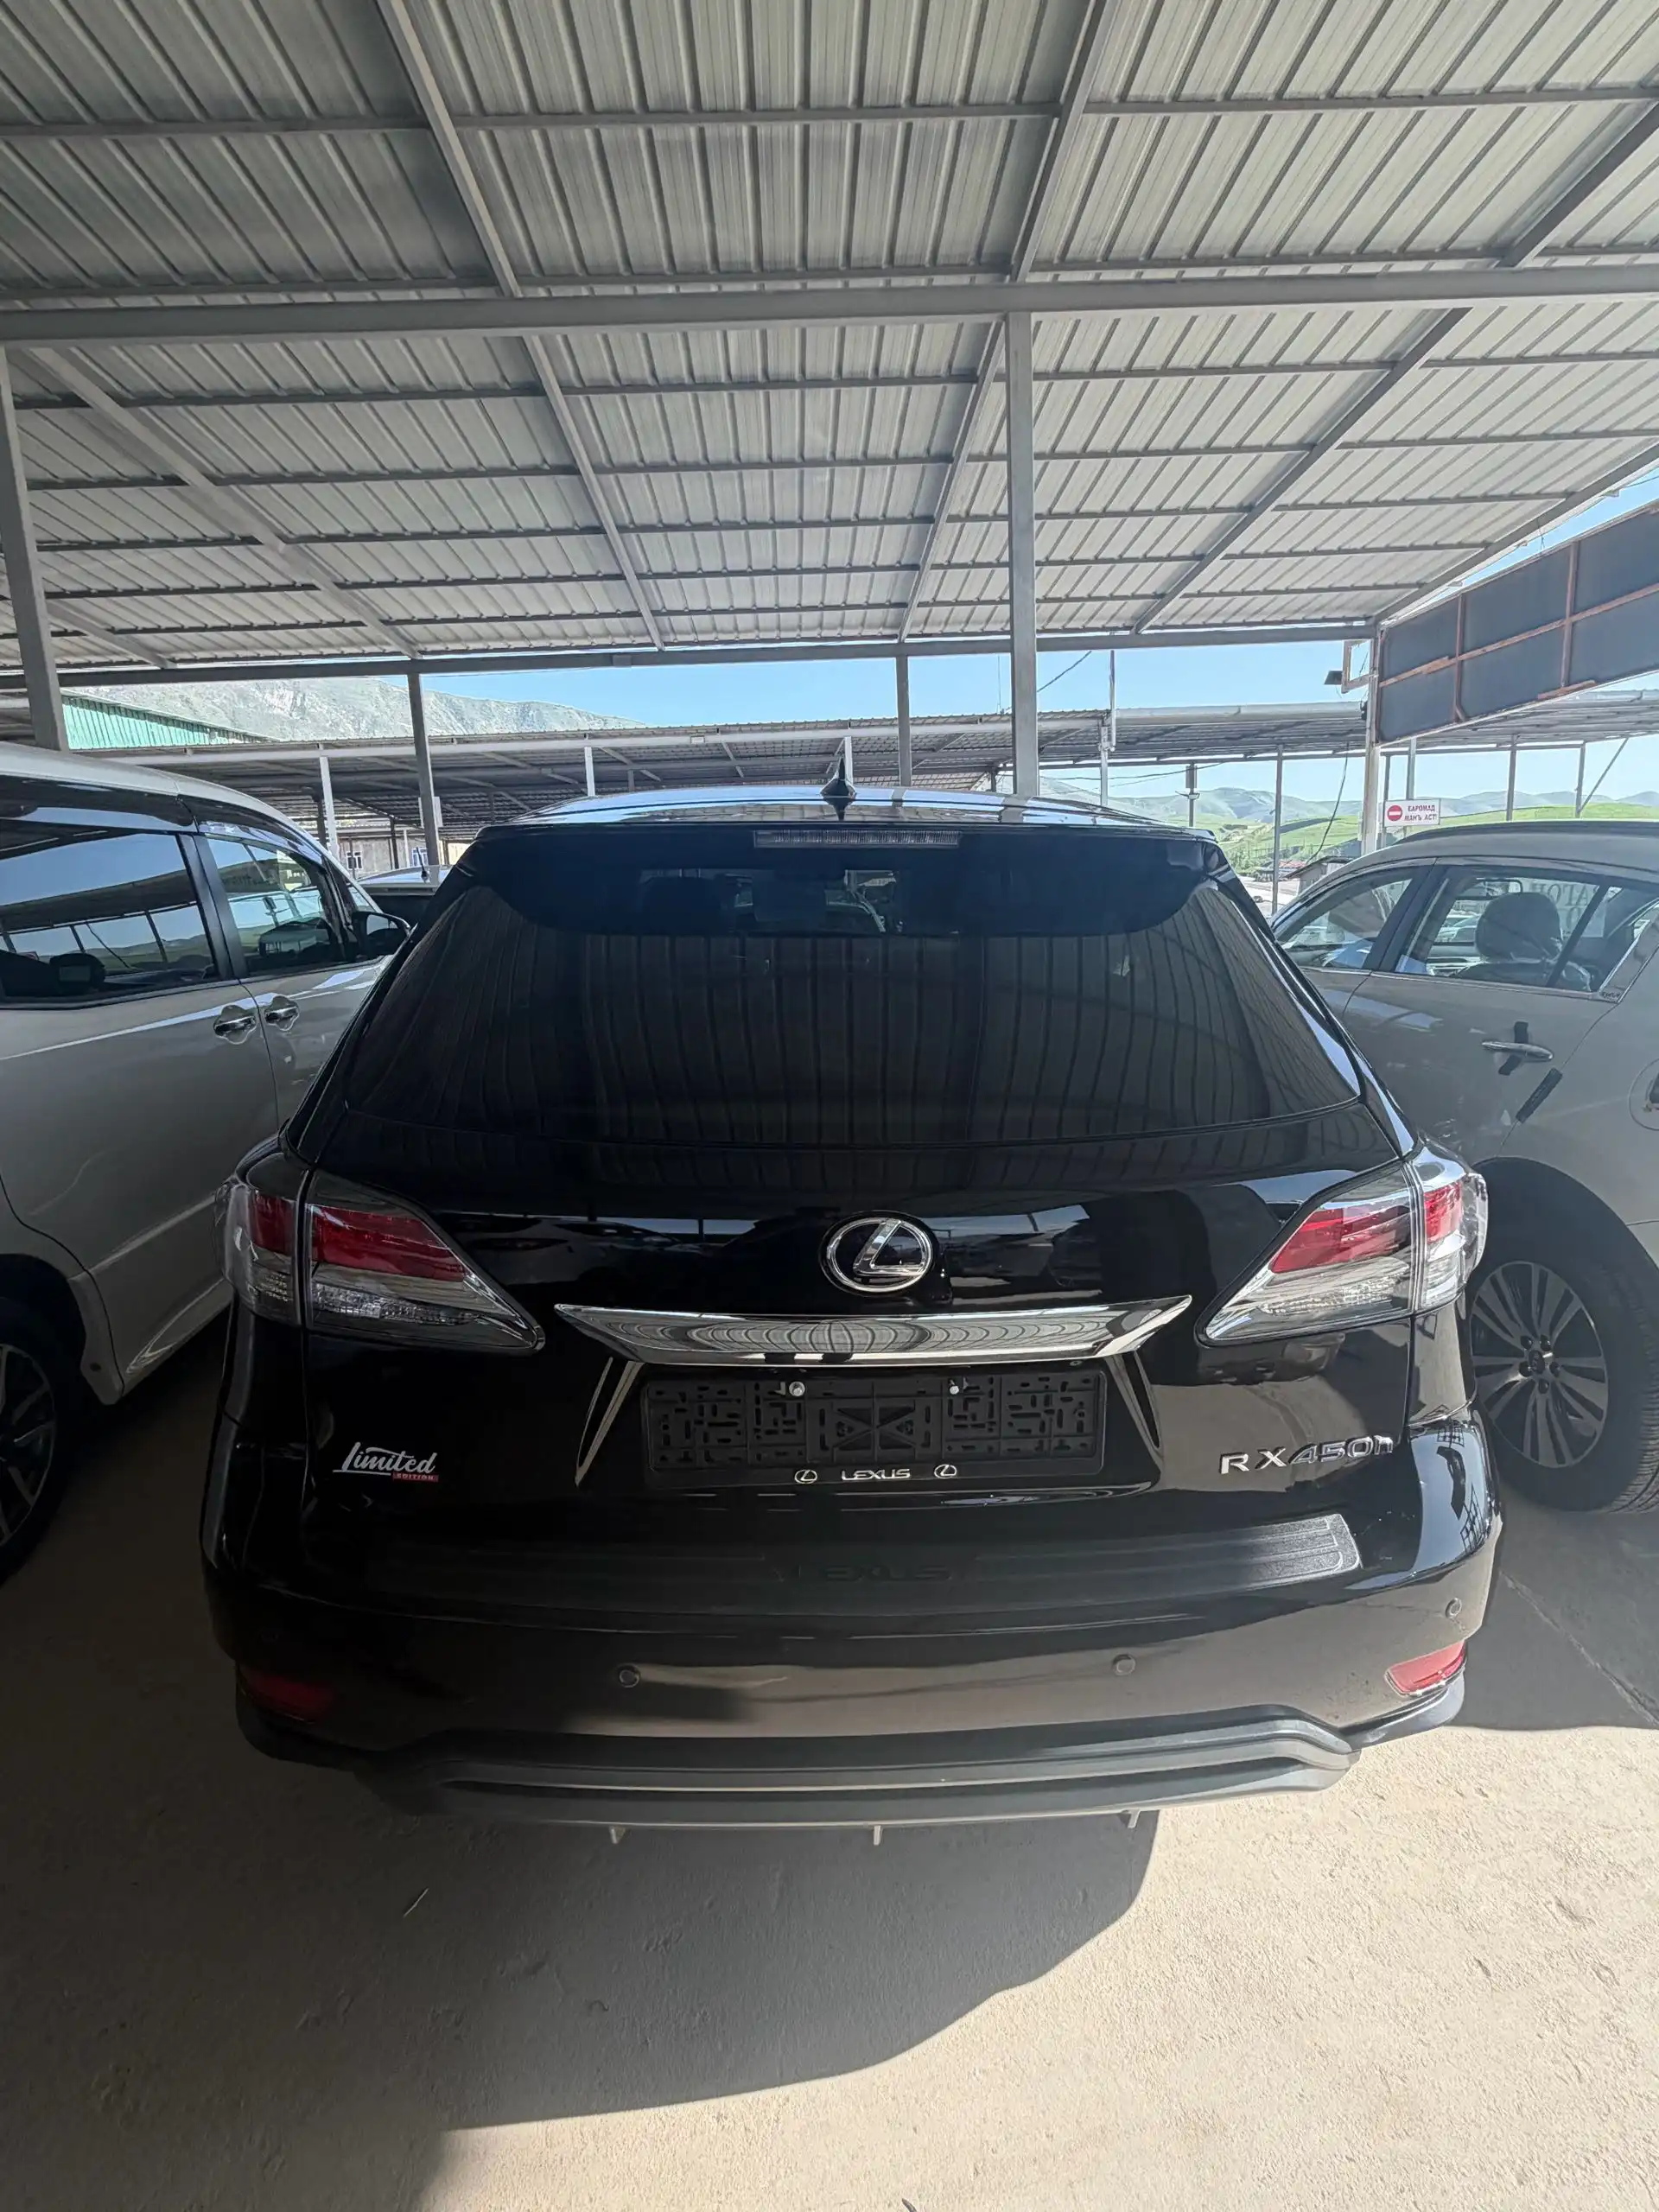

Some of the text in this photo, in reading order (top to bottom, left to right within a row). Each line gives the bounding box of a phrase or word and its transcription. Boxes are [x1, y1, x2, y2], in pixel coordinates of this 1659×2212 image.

[340, 1441, 439, 1474] Limited
[396, 1472, 435, 1481] EDITION
[842, 1468, 911, 1481] LEXUS
